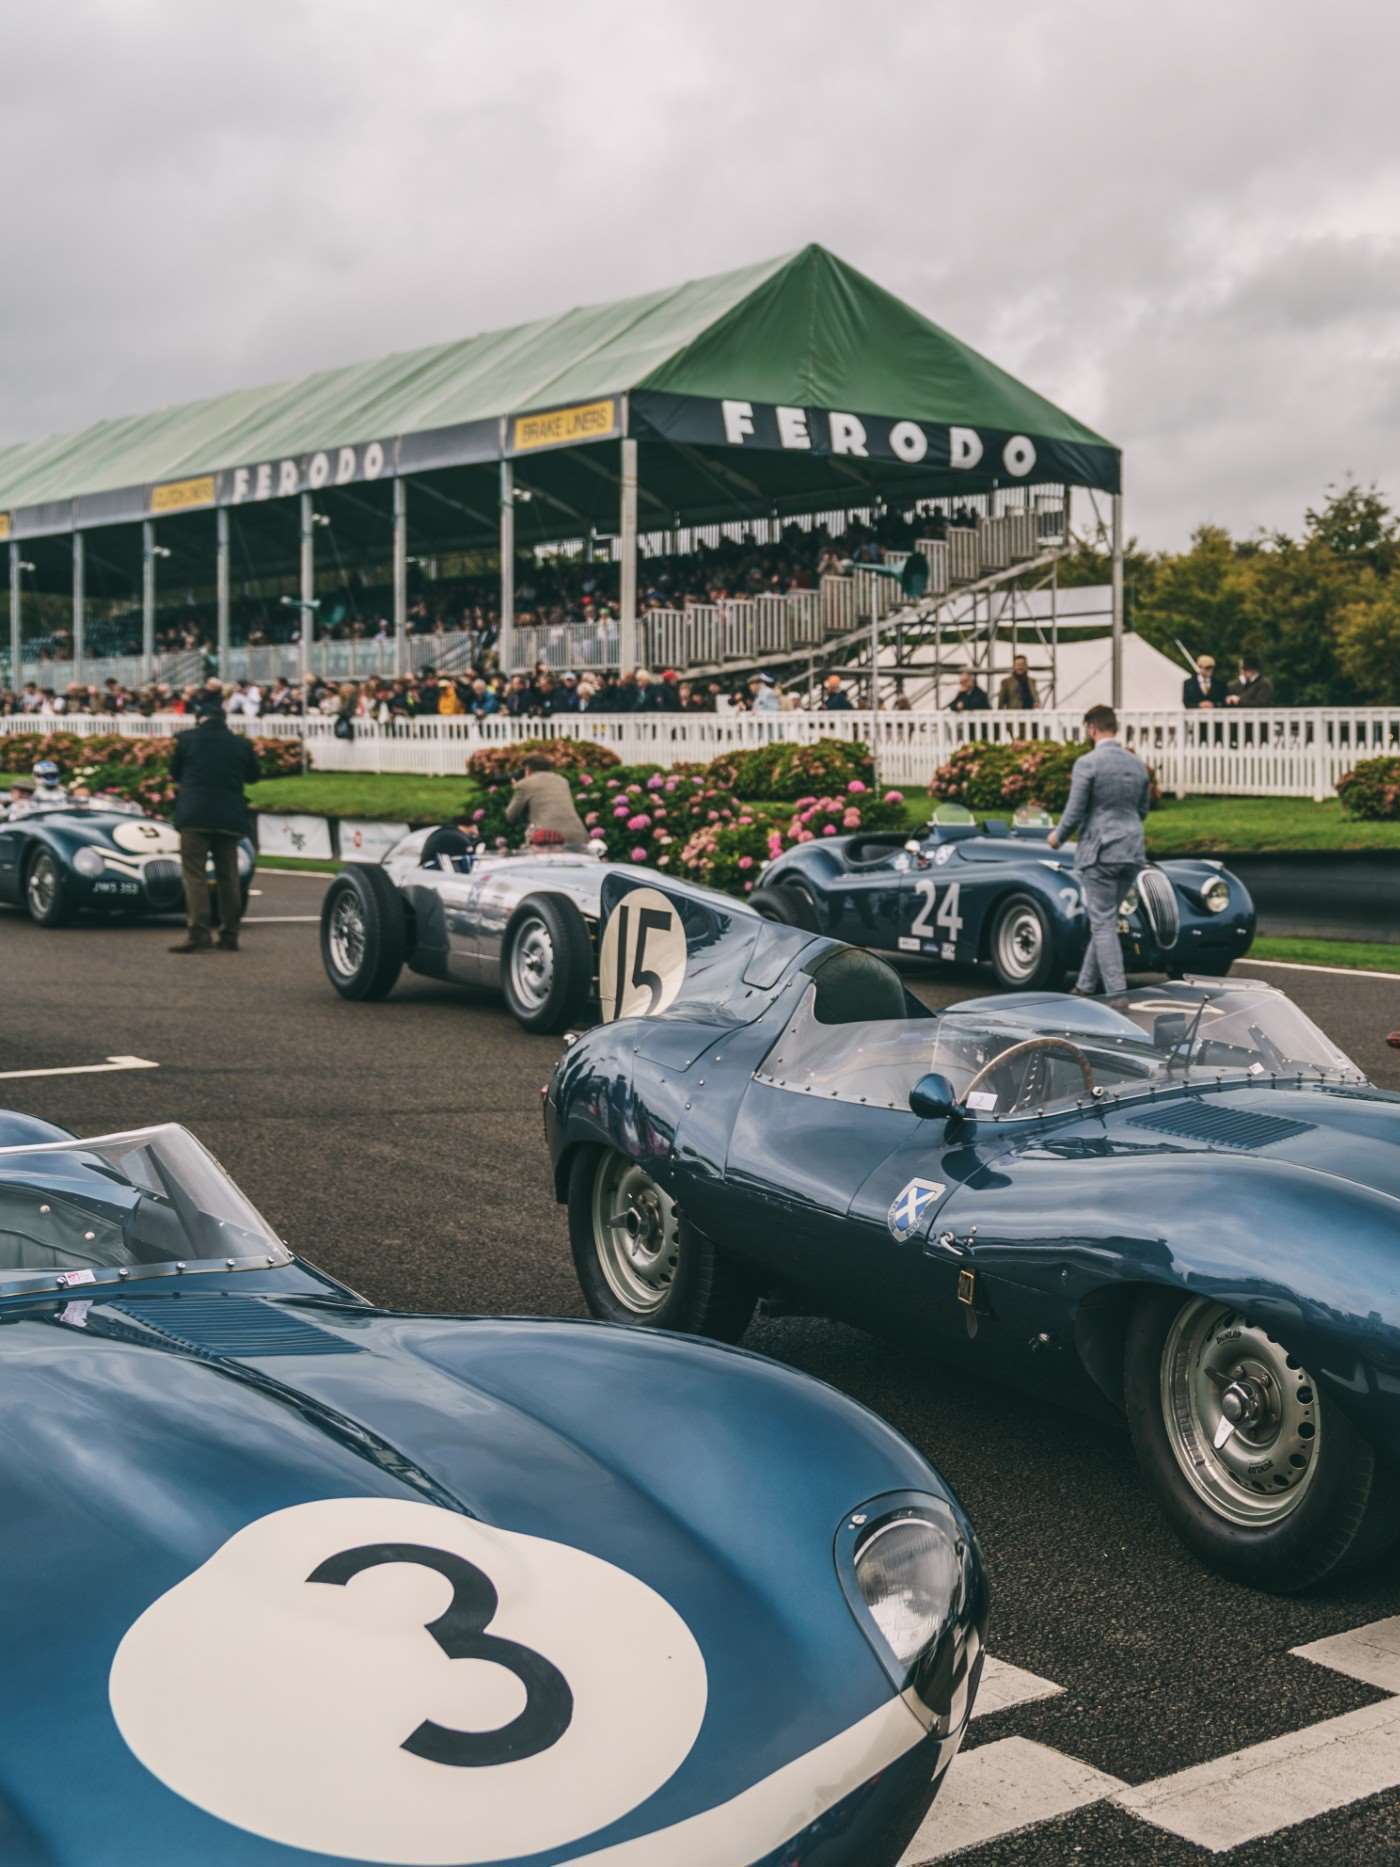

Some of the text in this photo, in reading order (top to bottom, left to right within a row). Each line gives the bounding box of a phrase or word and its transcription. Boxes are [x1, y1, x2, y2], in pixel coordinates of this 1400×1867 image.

[521, 414, 562, 442] BRAKE
[721, 399, 1037, 477] FERODO
[231, 442, 385, 504] FERODO
[911, 878, 963, 941] 24
[1058, 887, 1085, 919] 2
[613, 905, 672, 1020] 15
[304, 1542, 574, 1768] 3
